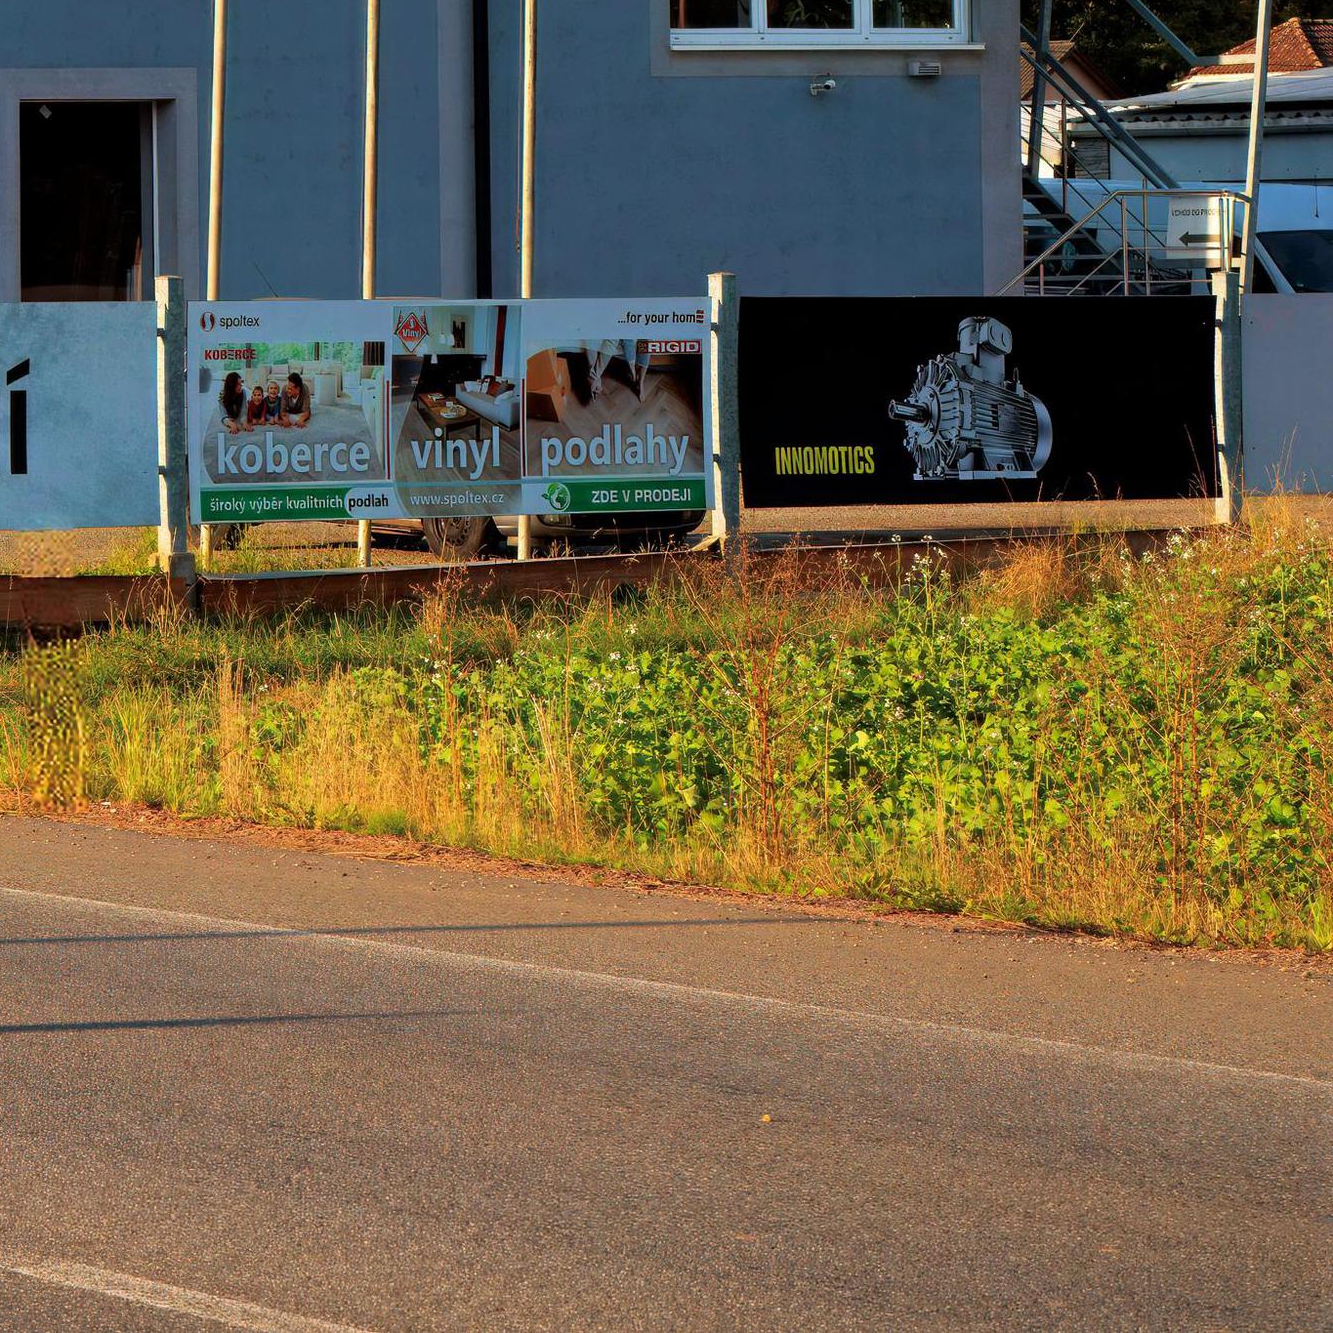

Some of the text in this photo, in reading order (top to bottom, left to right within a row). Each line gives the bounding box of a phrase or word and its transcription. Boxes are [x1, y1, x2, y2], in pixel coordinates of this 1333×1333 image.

[219, 314, 260, 329] spoltex
[644, 313, 670, 326] your
[647, 340, 700, 353] RIGID
[217, 431, 371, 475] koberce
[410, 426, 501, 481] vinyl
[540, 423, 690, 478] podlahy
[774, 445, 875, 475] INNOMOTICS
[209, 493, 389, 515] široký výběr kvalitních podlah
[409, 490, 506, 507] www.spoltex.cz
[590, 488, 692, 504] ZDE V PRODEJI
